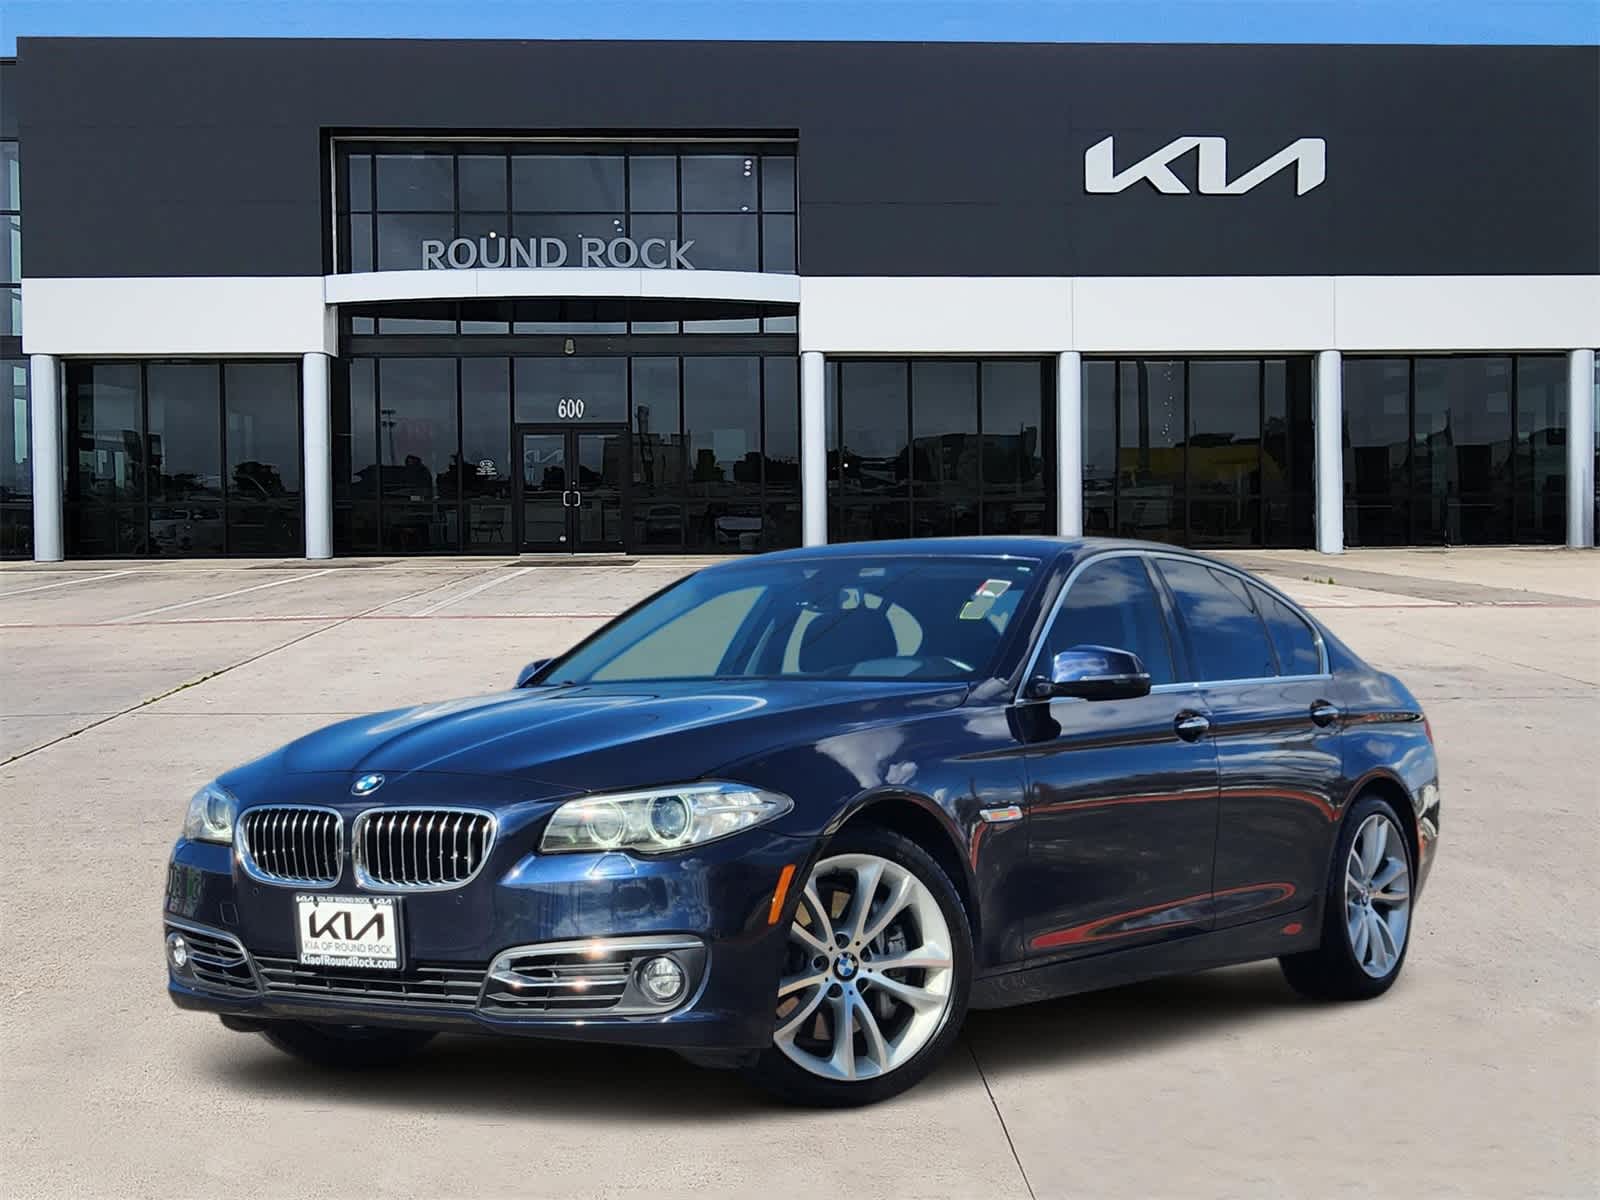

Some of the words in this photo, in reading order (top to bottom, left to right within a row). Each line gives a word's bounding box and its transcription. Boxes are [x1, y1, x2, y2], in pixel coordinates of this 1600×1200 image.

[1084, 136, 1326, 196] KIA
[422, 238, 568, 270] ROUND
[581, 237, 696, 270] ROCK
[558, 399, 584, 418] 600
[308, 910, 385, 941] KIA
[304, 941, 320, 950] KIA
[321, 942, 333, 951] OF
[334, 943, 366, 953] ROUND
[368, 945, 392, 954] ROCK
[301, 954, 397, 968] KiaofRoundRock.com
